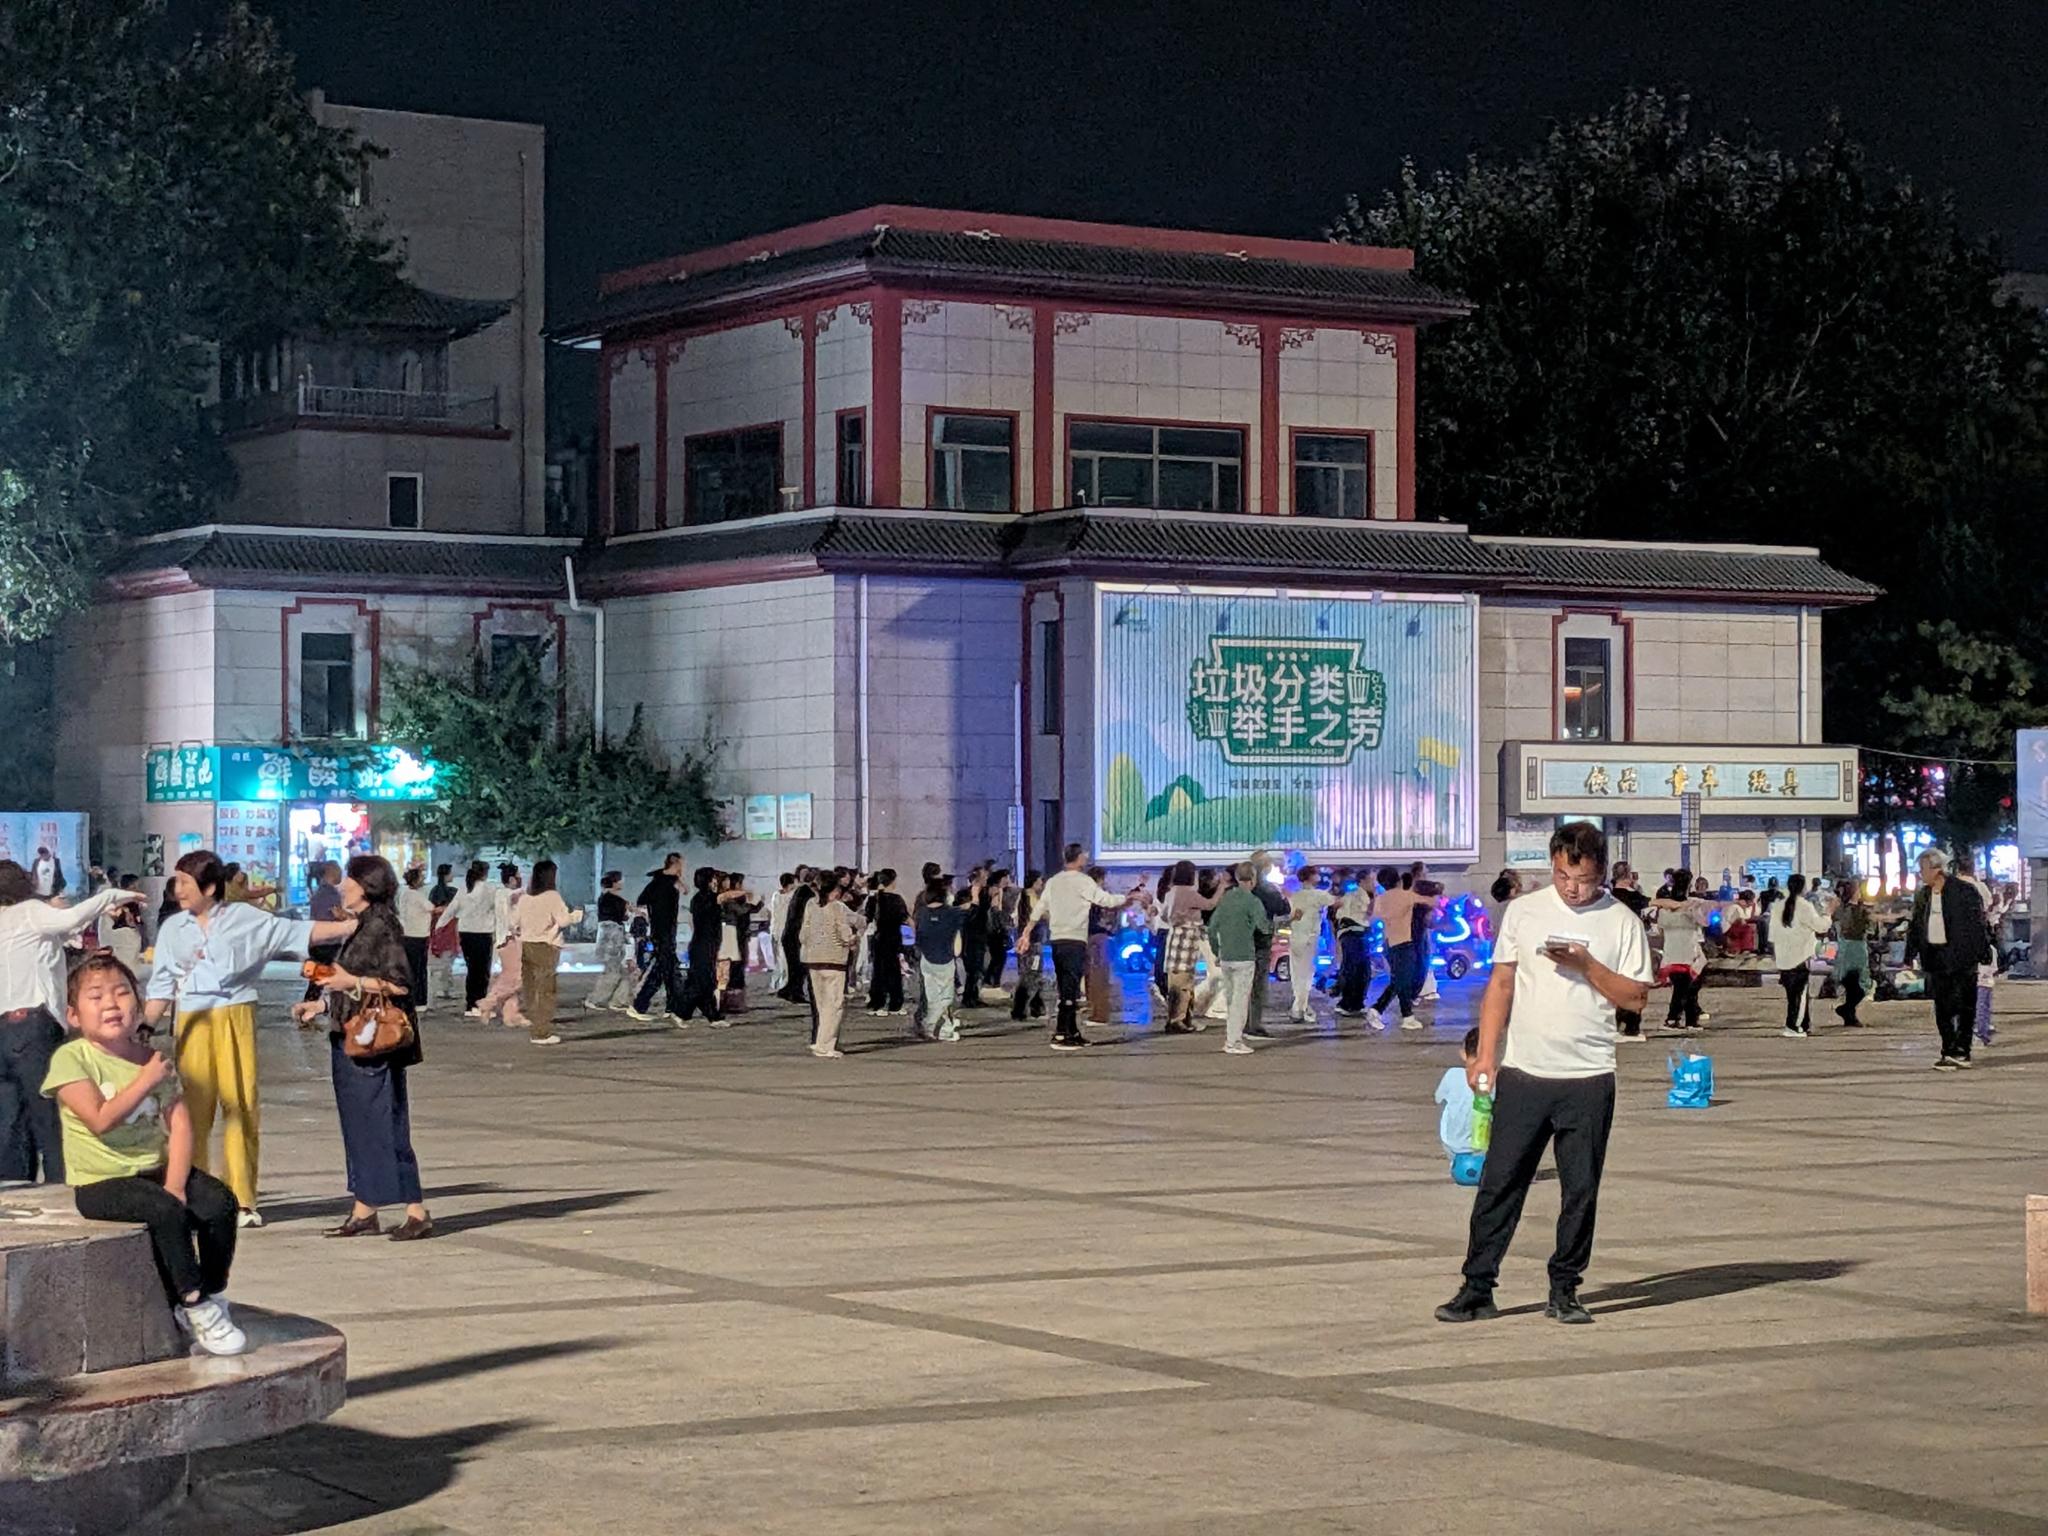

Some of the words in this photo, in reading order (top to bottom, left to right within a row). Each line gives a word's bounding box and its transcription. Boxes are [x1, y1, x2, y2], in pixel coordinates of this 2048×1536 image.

[1192, 662, 1345, 706] 垃圾分类
[1231, 704, 1383, 748] 举手之劳
